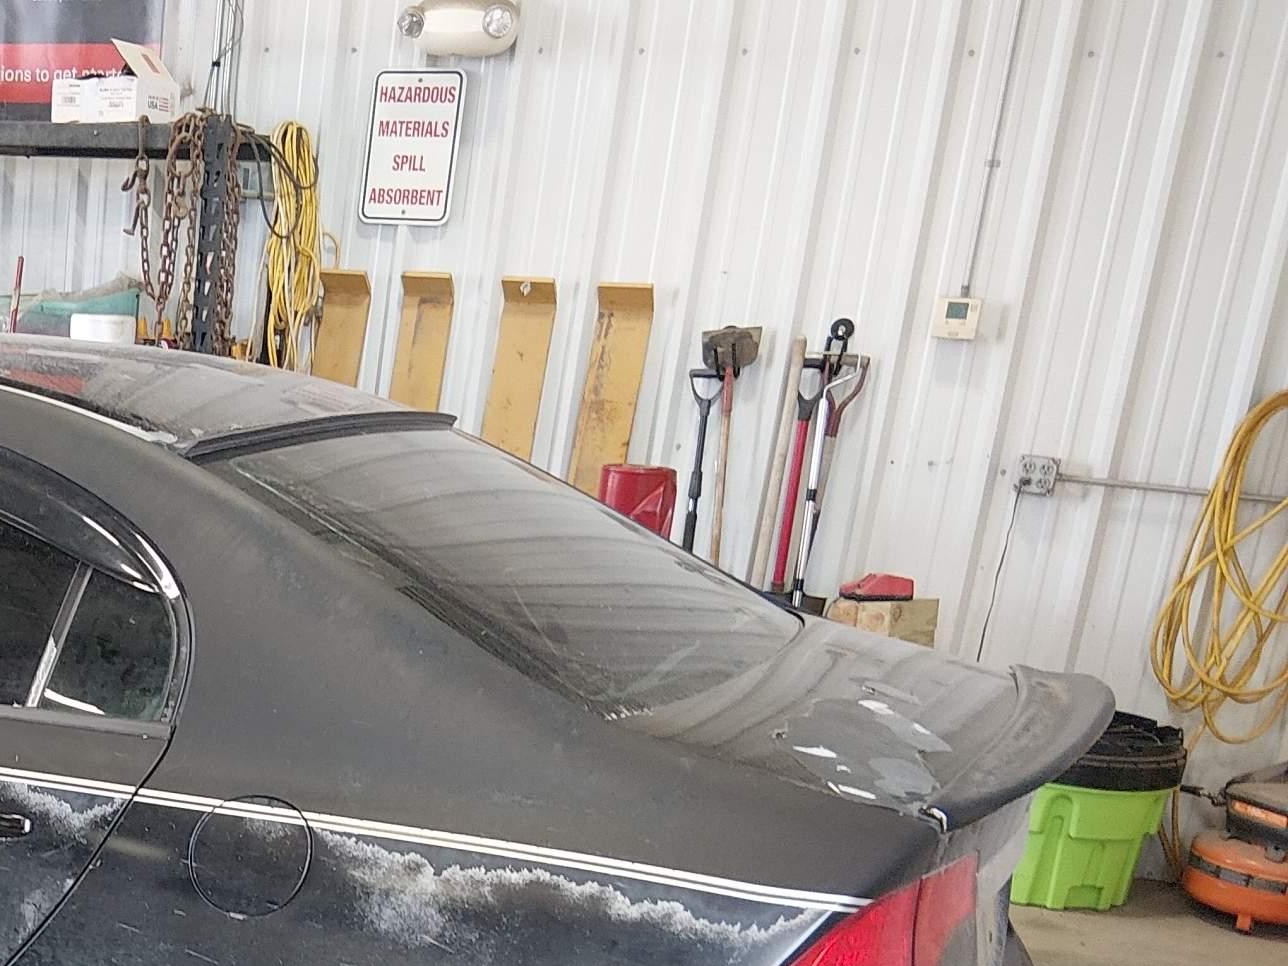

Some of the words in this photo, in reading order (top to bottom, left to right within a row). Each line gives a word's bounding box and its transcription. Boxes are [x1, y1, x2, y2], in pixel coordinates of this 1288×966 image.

[35, 68, 50, 82] to
[379, 86, 457, 104] HAZARDOUS
[147, 99, 158, 110] USA
[378, 120, 450, 138] MATERIALS
[392, 154, 426, 172] SPILL
[368, 188, 444, 206] ABSORBENT
